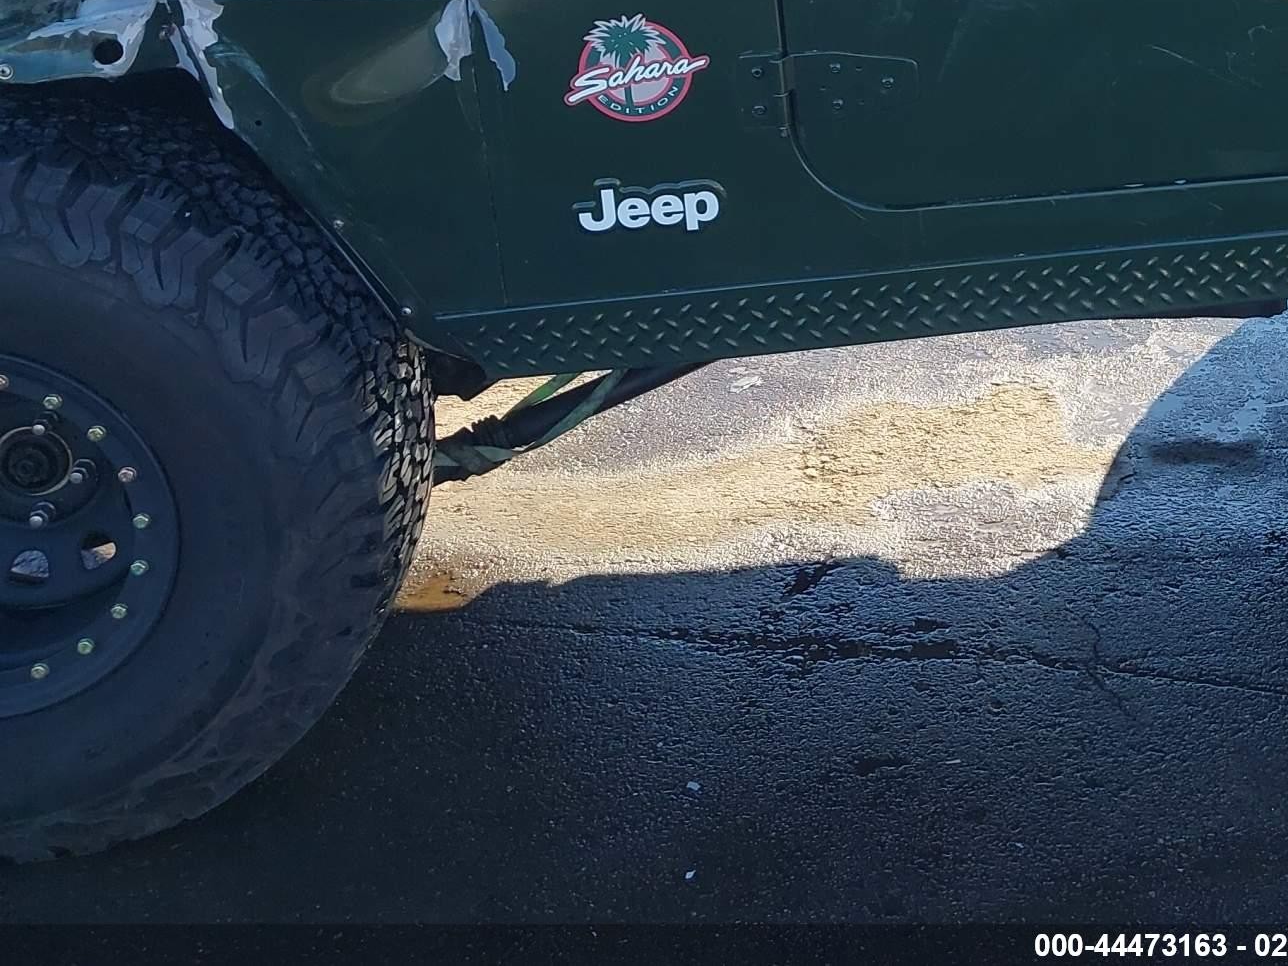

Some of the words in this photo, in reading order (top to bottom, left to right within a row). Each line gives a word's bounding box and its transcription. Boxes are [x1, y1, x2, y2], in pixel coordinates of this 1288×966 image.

[567, 55, 707, 103] Sahara
[597, 86, 679, 114] EDITION
[578, 188, 720, 232] Jeep
